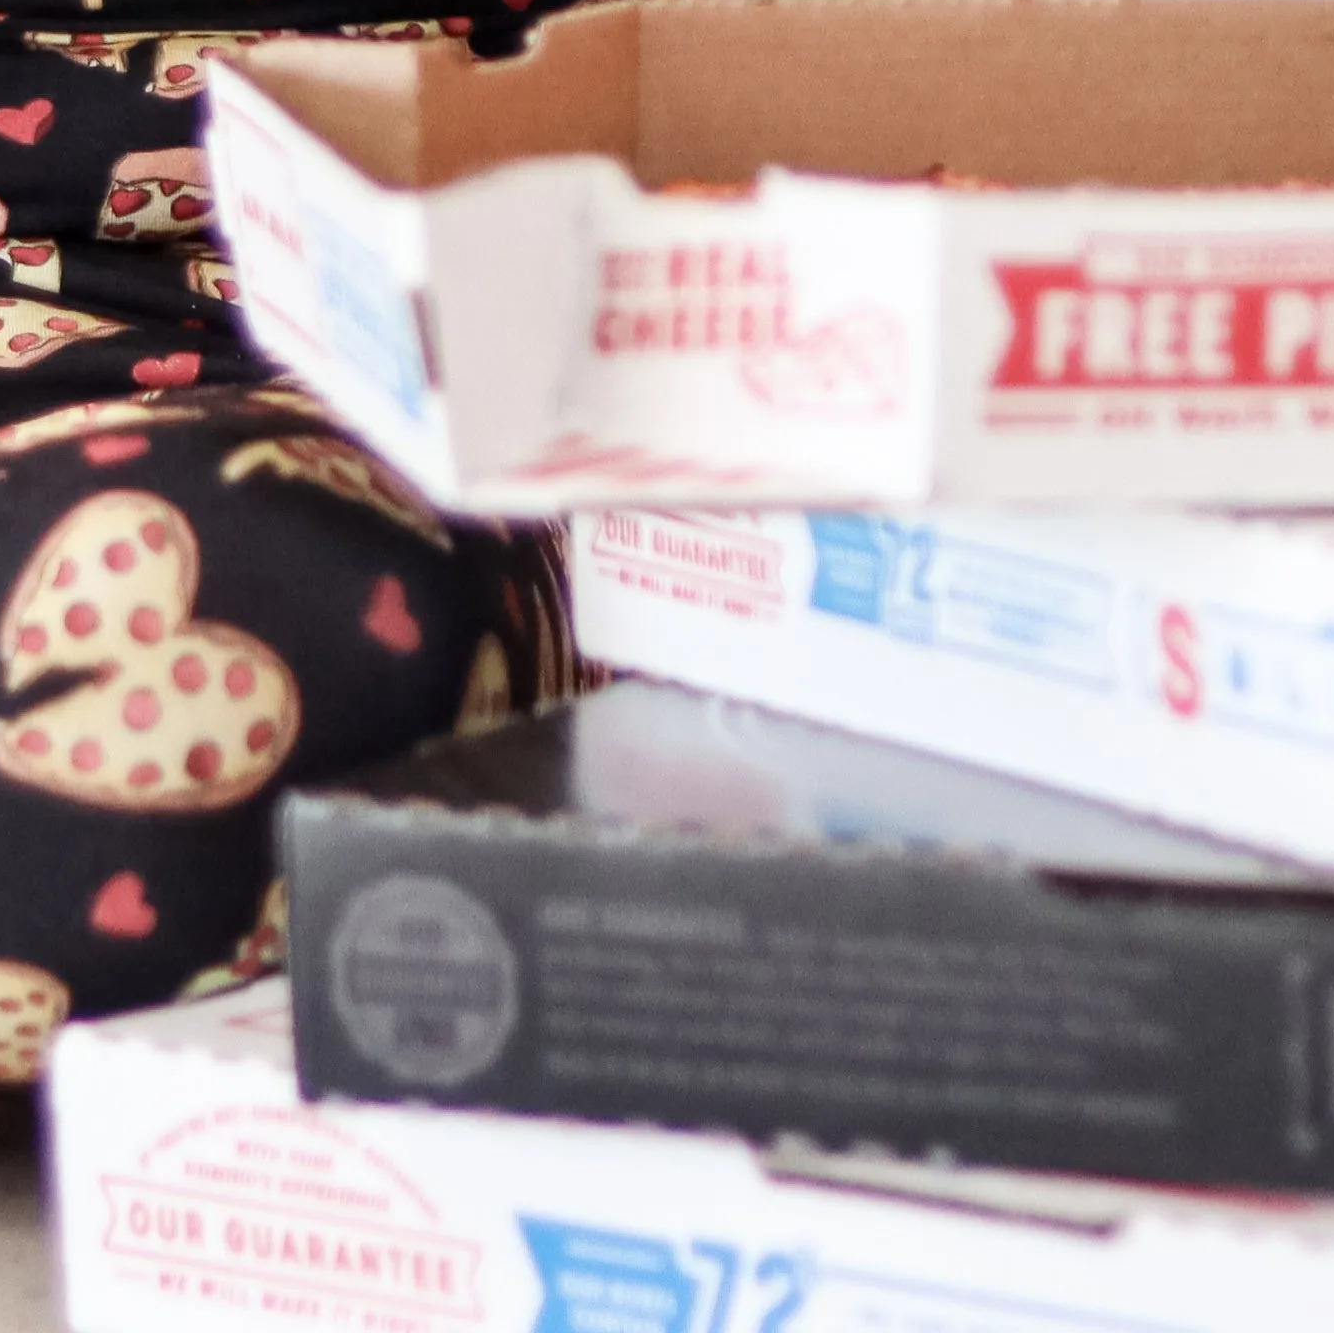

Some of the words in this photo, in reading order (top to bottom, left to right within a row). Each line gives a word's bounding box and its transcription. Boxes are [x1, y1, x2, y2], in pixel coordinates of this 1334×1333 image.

[1033, 287, 1237, 380] FREE
[128, 1199, 205, 1245] OUR
[224, 1217, 454, 1294] GUARANTEE
